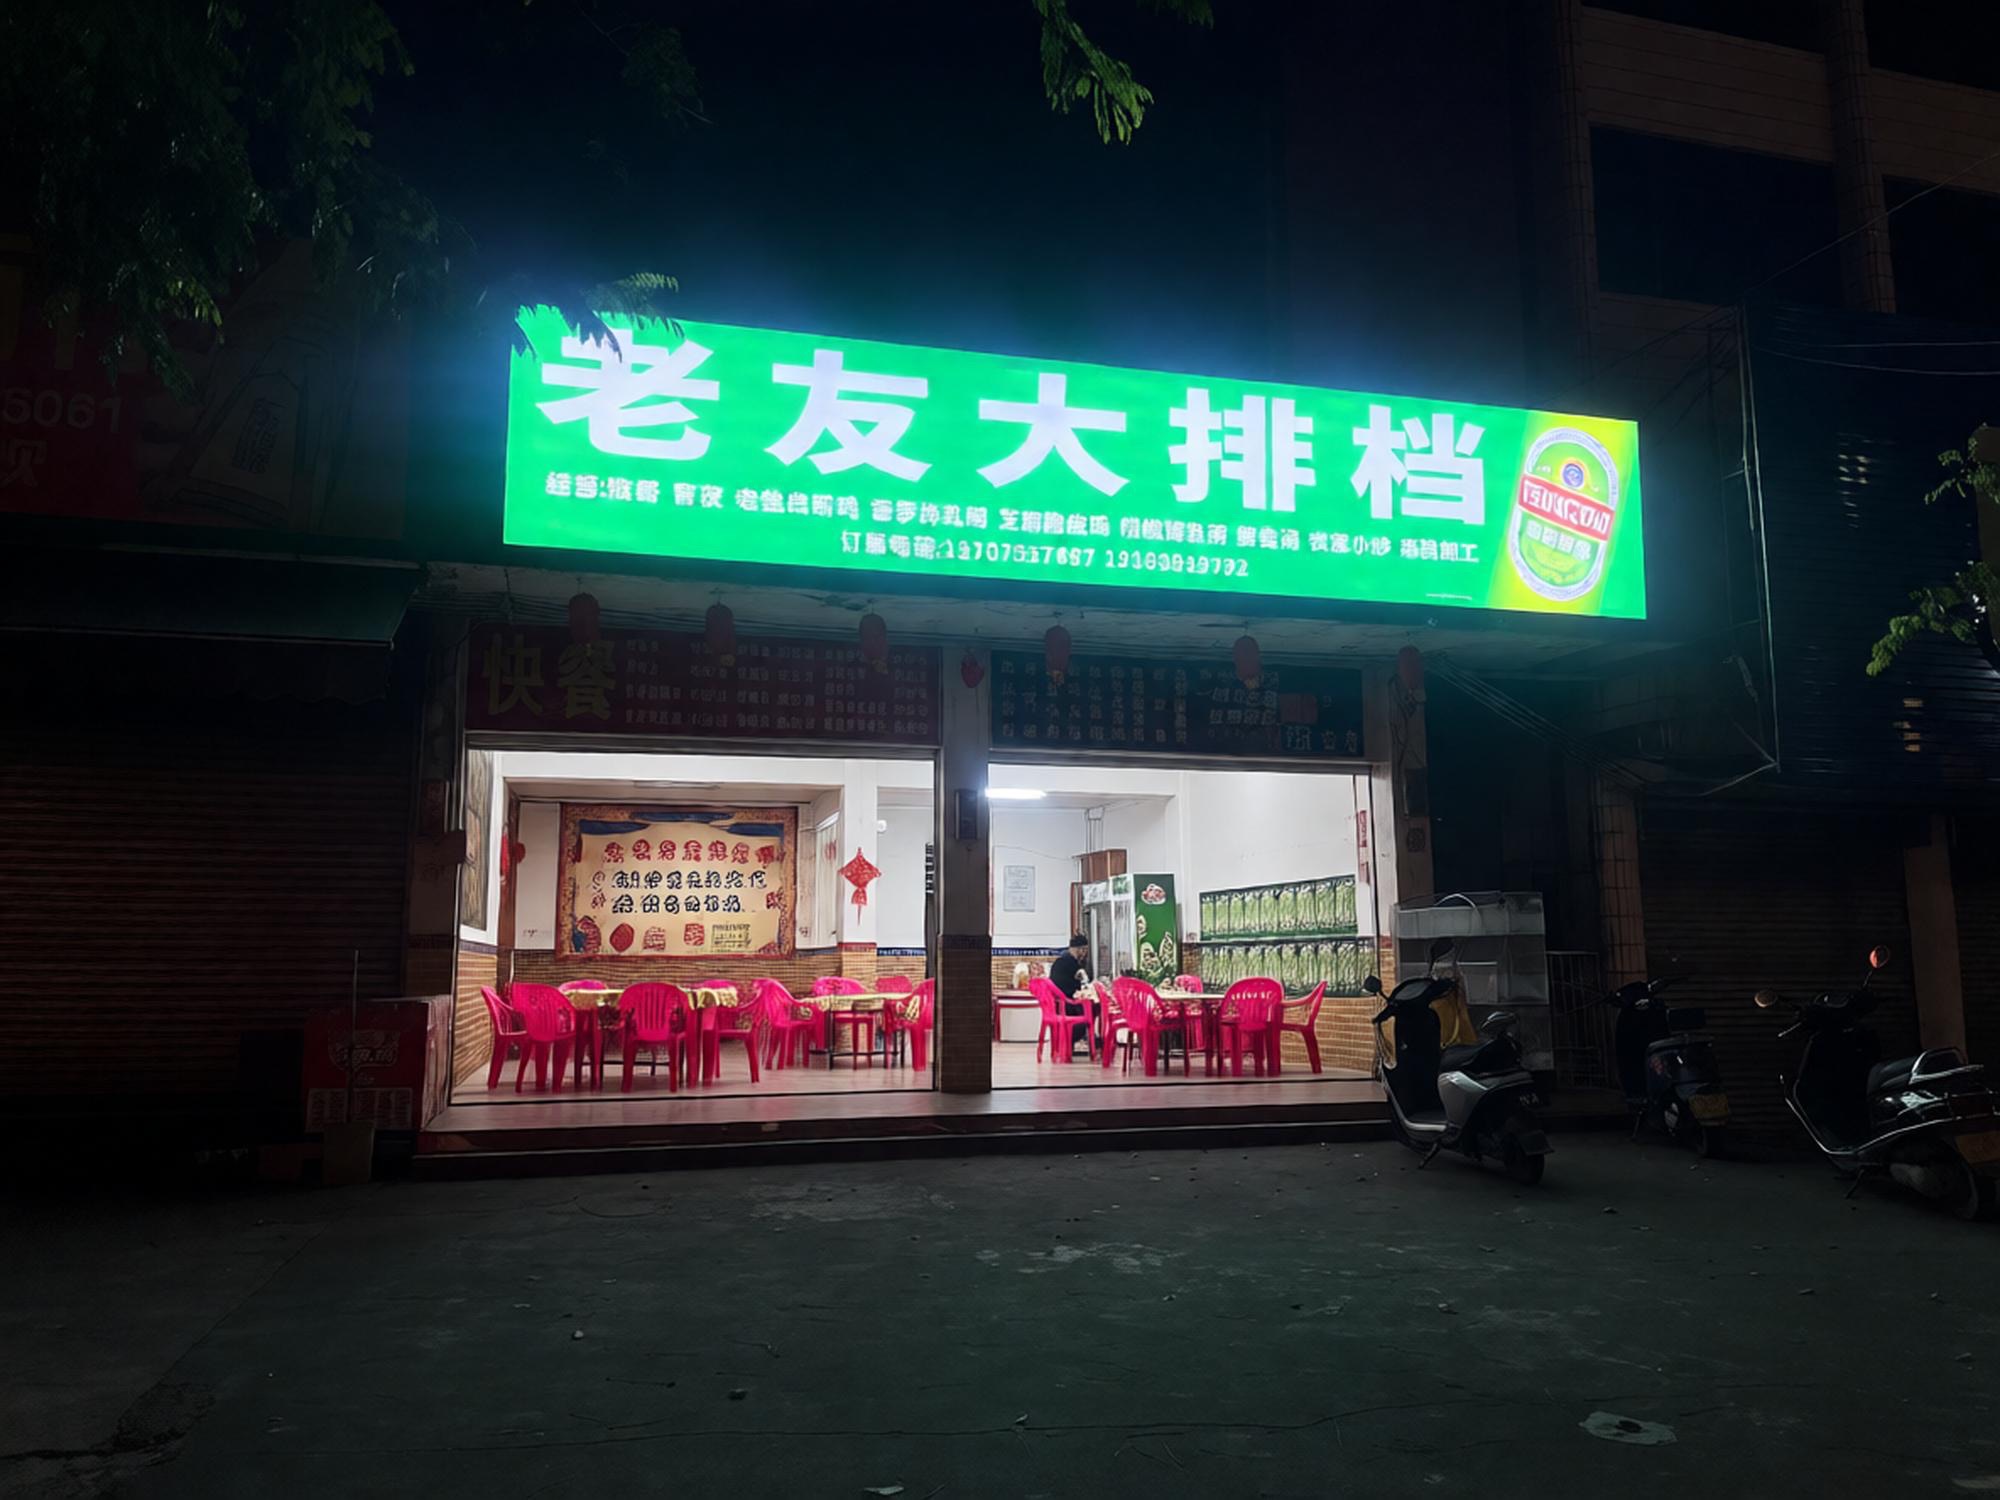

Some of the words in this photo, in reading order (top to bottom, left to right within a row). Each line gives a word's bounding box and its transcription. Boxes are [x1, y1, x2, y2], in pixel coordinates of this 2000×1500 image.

[536, 326, 1486, 526] 老友大排档
